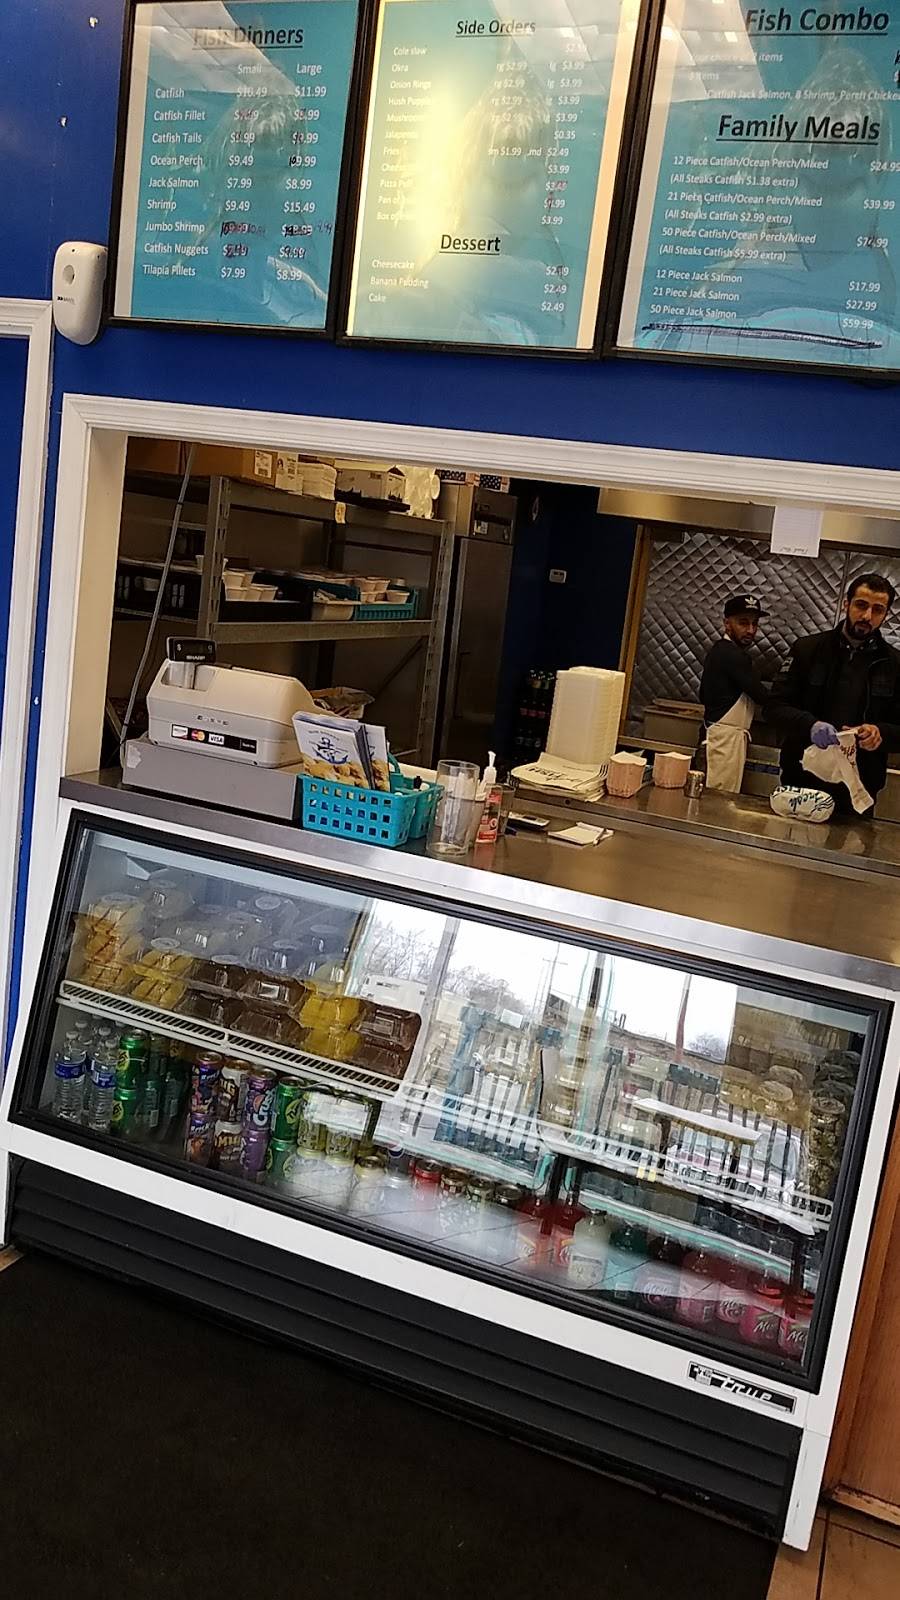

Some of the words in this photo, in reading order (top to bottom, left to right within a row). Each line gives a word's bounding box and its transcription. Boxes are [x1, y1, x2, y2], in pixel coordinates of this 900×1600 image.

[746, 7, 792, 31] Fish
[800, 7, 889, 31] Combo
[456, 20, 485, 35] Side
[489, 20, 536, 33] Orders
[193, 27, 226, 45] Fish
[234, 26, 304, 44] Dinners
[393, 47, 409, 56] Cole
[759, 53, 783, 62] items
[238, 64, 262, 74] Small
[296, 64, 322, 76] Large
[392, 64, 408, 72] Okra
[560, 78, 583, 88] $3.99
[155, 88, 185, 99] Catfish
[294, 86, 326, 97] $11.99
[558, 96, 580, 105] $3.99
[154, 111, 182, 121] Catfish
[185, 111, 205, 121] Fillet
[556, 113, 578, 122] $3.99
[719, 115, 798, 141] Family
[805, 116, 881, 140] Meals
[152, 133, 181, 143] Catfish
[183, 133, 202, 144] Tails
[554, 130, 576, 140] $0.35
[500, 147, 521, 156] $1.99
[547, 148, 569, 156] $2.49
[151, 156, 176, 166] Ocean
[178, 156, 203, 167] Perch
[228, 156, 254, 166] $9.49
[674, 156, 684, 165] 12
[686, 157, 707, 166] Piece
[709, 157, 770, 168] Catfish/Ocean
[771, 159, 828, 170] Perch/Mixed
[548, 164, 570, 174] $3.99
[149, 178, 166, 188] Jack
[167, 178, 199, 188] Salmon
[227, 178, 252, 189] $7.99
[286, 179, 312, 190] $8.99
[671, 174, 684, 184] (All
[686, 174, 713, 184] Steaks
[715, 175, 744, 185] Catfish
[746, 175, 771, 186] $1.38
[772, 177, 798, 188] extra)
[147, 200, 177, 210] Shrimp
[225, 201, 250, 212] $9.49
[284, 202, 315, 213] $15.49
[667, 192, 678, 201] 21
[704, 193, 764, 205] Catfish/Ocean
[766, 195, 822, 207] Perch/Mixed
[863, 199, 895, 210] $39.99
[541, 215, 563, 225] $3.99
[665, 210, 678, 220] (All
[680, 210, 707, 220] Steaks
[709, 211, 738, 222] Catfish
[740, 212, 765, 223] $2.99
[766, 213, 792, 225] extra)
[145, 222, 173, 232] Jumbo
[175, 223, 205, 234] Shrimp
[662, 228, 673, 236] 50
[674, 228, 697, 238] Piece
[698, 229, 758, 241] Catfish/Ocean
[759, 231, 816, 243] Perch/Mixed
[144, 244, 173, 254] Catfish
[175, 245, 209, 255] Nuggets
[441, 235, 501, 252] Dessert
[659, 245, 673, 255] (All
[675, 245, 702, 256] Steaks
[704, 246, 733, 258] Catfish
[734, 248, 759, 259] $5.99
[760, 250, 786, 261] extra)
[372, 260, 415, 269] Cheesecake
[143, 265, 170, 275] Tilapia
[221, 267, 246, 279] $7.99
[276, 269, 302, 281] $8.99
[370, 277, 397, 286] Banana
[656, 270, 666, 278] 12
[668, 270, 690, 280] Piece
[692, 271, 709, 281] Jack
[711, 272, 742, 283] Salmon
[849, 281, 881, 292] $17.99
[369, 294, 386, 303] Cake
[541, 302, 564, 312] $2.49
[653, 287, 664, 296] 21
[665, 288, 687, 298] Piece
[689, 289, 707, 300] Jack
[708, 290, 740, 301] Salmon
[846, 300, 877, 311] $27.99
[650, 305, 662, 314] 50
[663, 306, 684, 316] Piece
[686, 306, 704, 317] Jack
[705, 308, 737, 319] Salmon
[842, 318, 874, 330] $59.99
